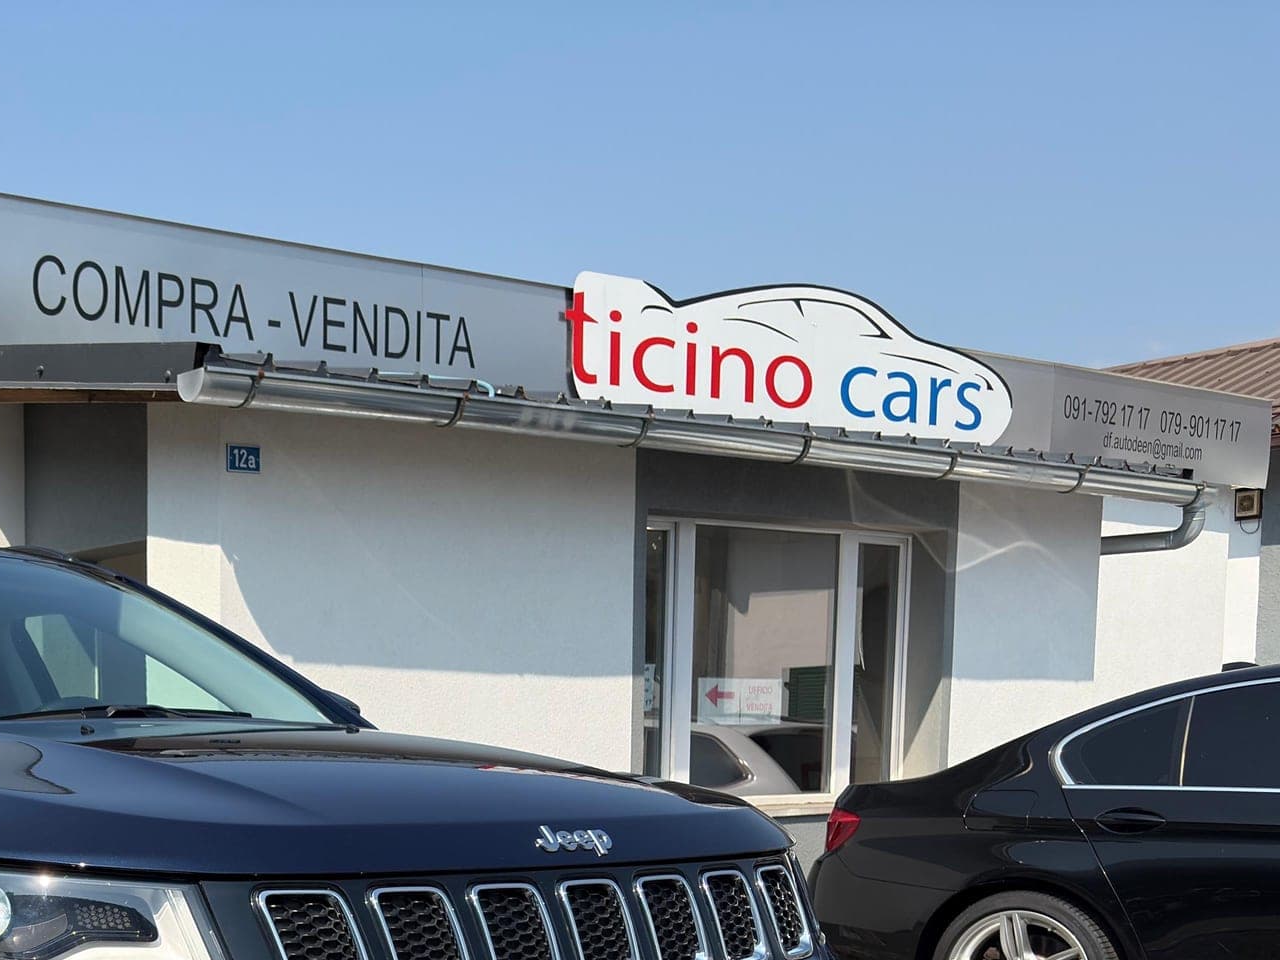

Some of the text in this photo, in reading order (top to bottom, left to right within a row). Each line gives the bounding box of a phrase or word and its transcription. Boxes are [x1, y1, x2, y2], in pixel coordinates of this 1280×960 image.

[32, 254, 254, 341] COMPRA
[565, 291, 983, 431] ticino cars
[1063, 394, 1117, 426] 091-792
[1121, 404, 1134, 428] 17
[1138, 406, 1151, 430] 17
[1214, 417, 1227, 441] 17
[1229, 420, 1242, 443] 17
[233, 448, 257, 469] 12a
[1103, 431, 1203, 461] df.autodeen@gmail.com
[535, 825, 613, 857] Jeep
